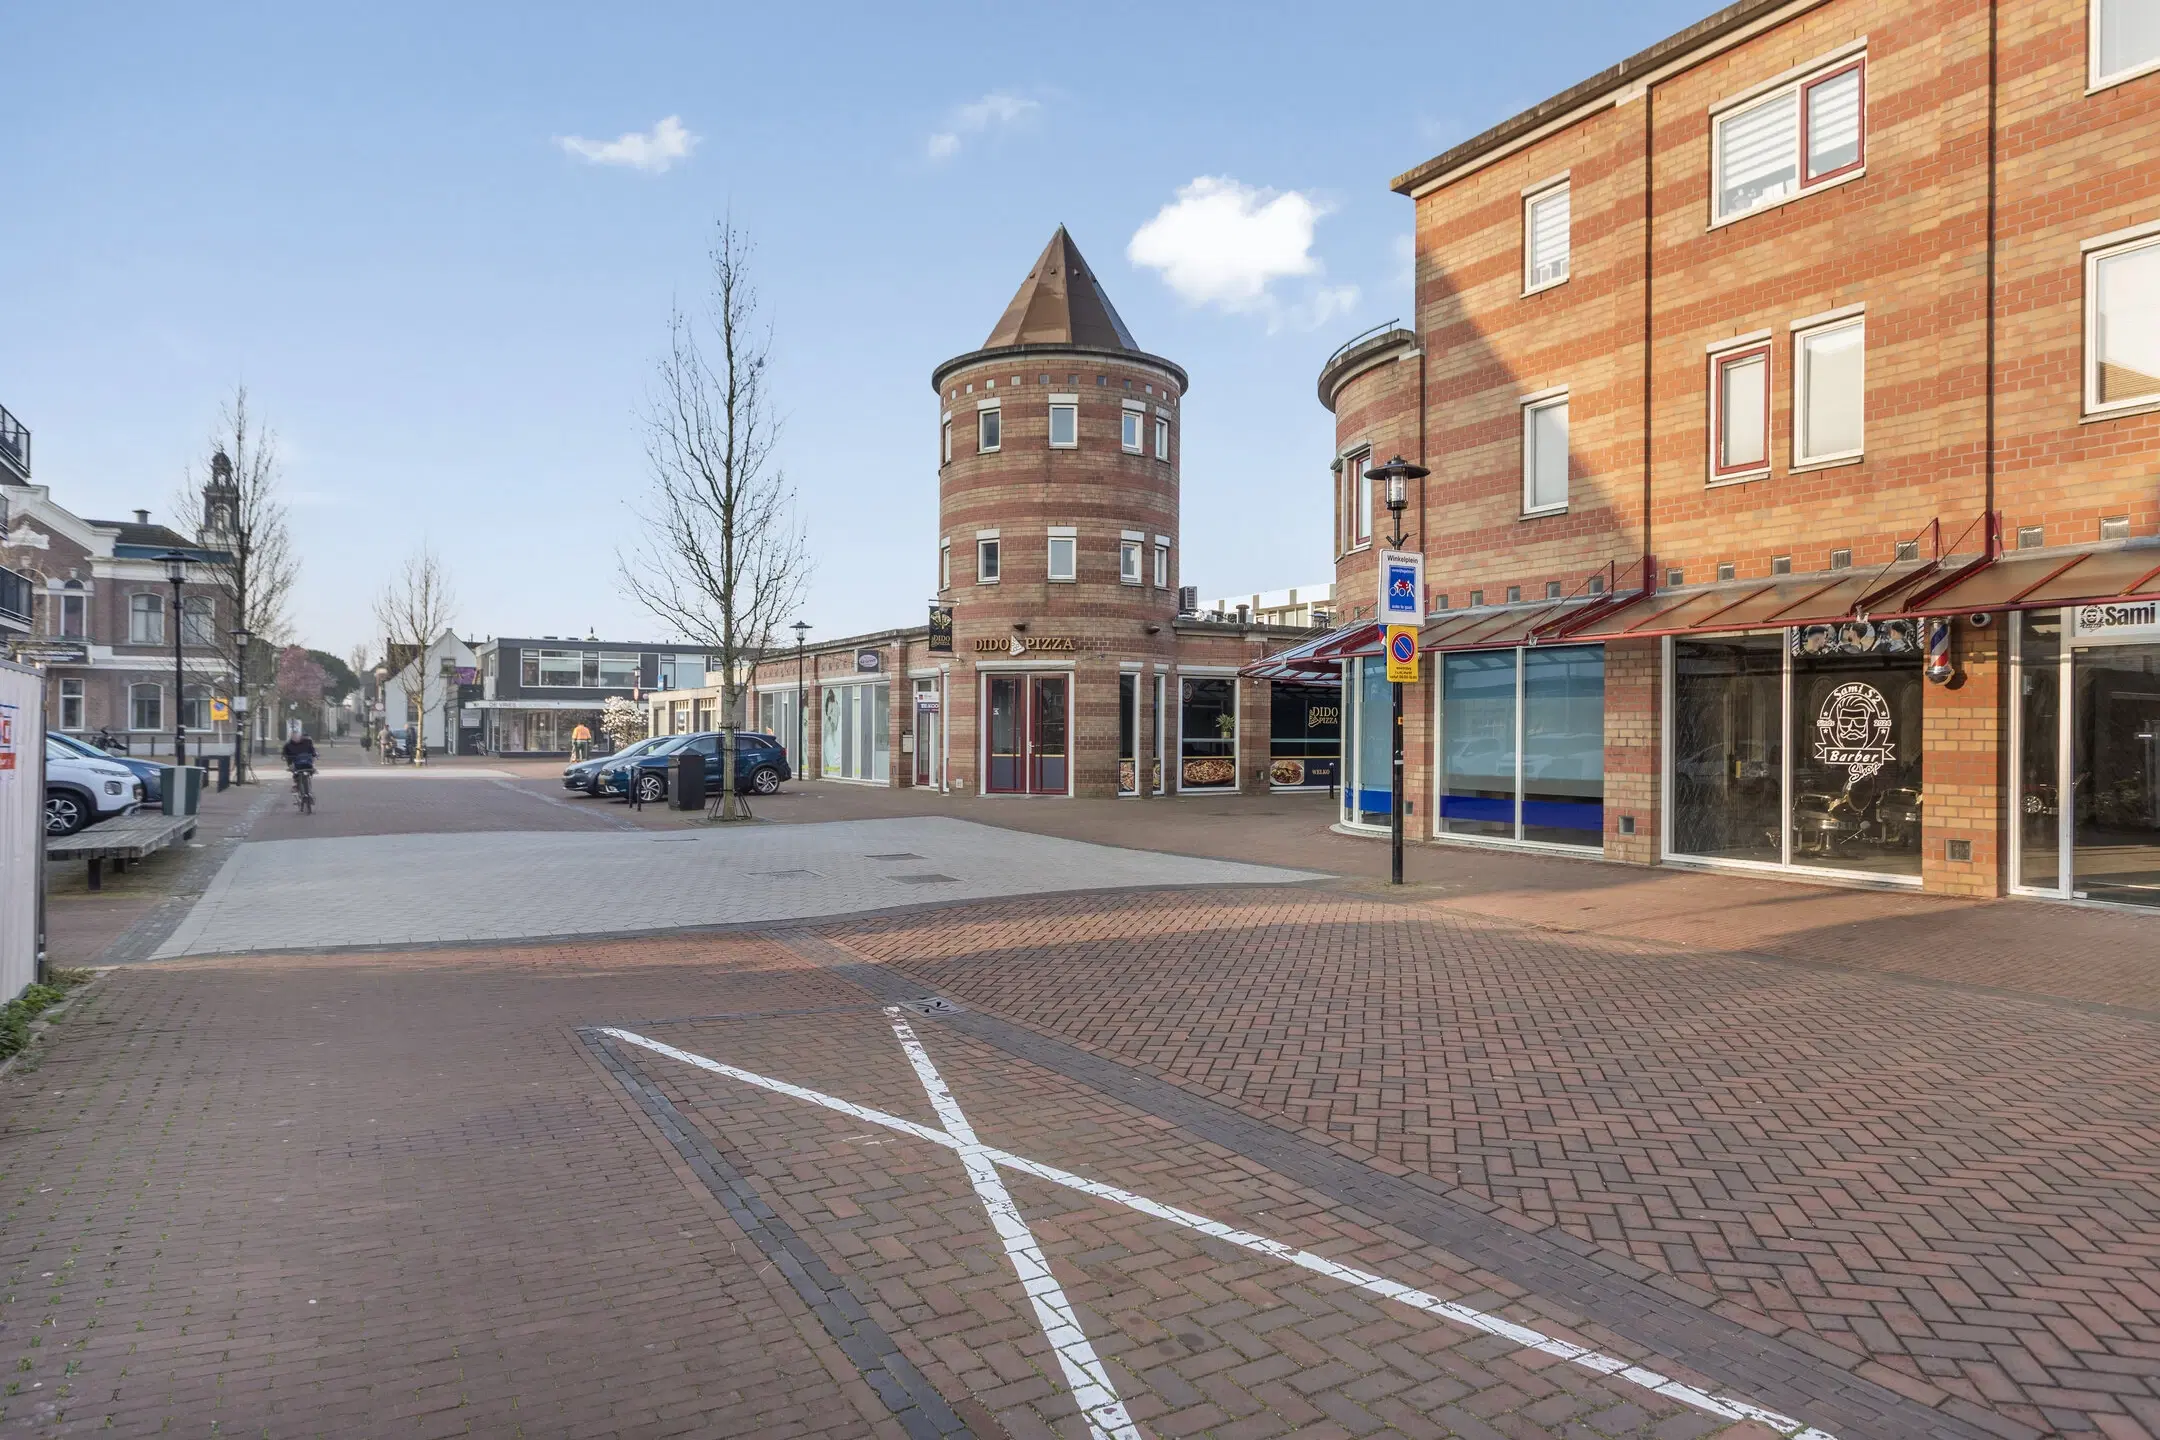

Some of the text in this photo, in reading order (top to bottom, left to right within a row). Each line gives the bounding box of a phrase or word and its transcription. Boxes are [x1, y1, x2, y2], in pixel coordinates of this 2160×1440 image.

[1387, 555, 1419, 564] Winkelplein
[2105, 603, 2156, 626] Sami
[974, 637, 1076, 651] DIDO PIZZA
[1833, 684, 1864, 701] Sami
[1312, 706, 1339, 717] DIDO
[1319, 717, 1338, 725] PIZZA
[1873, 719, 1892, 727] 2024
[1829, 750, 1879, 762] Barber
[1848, 761, 1882, 784] Shop
